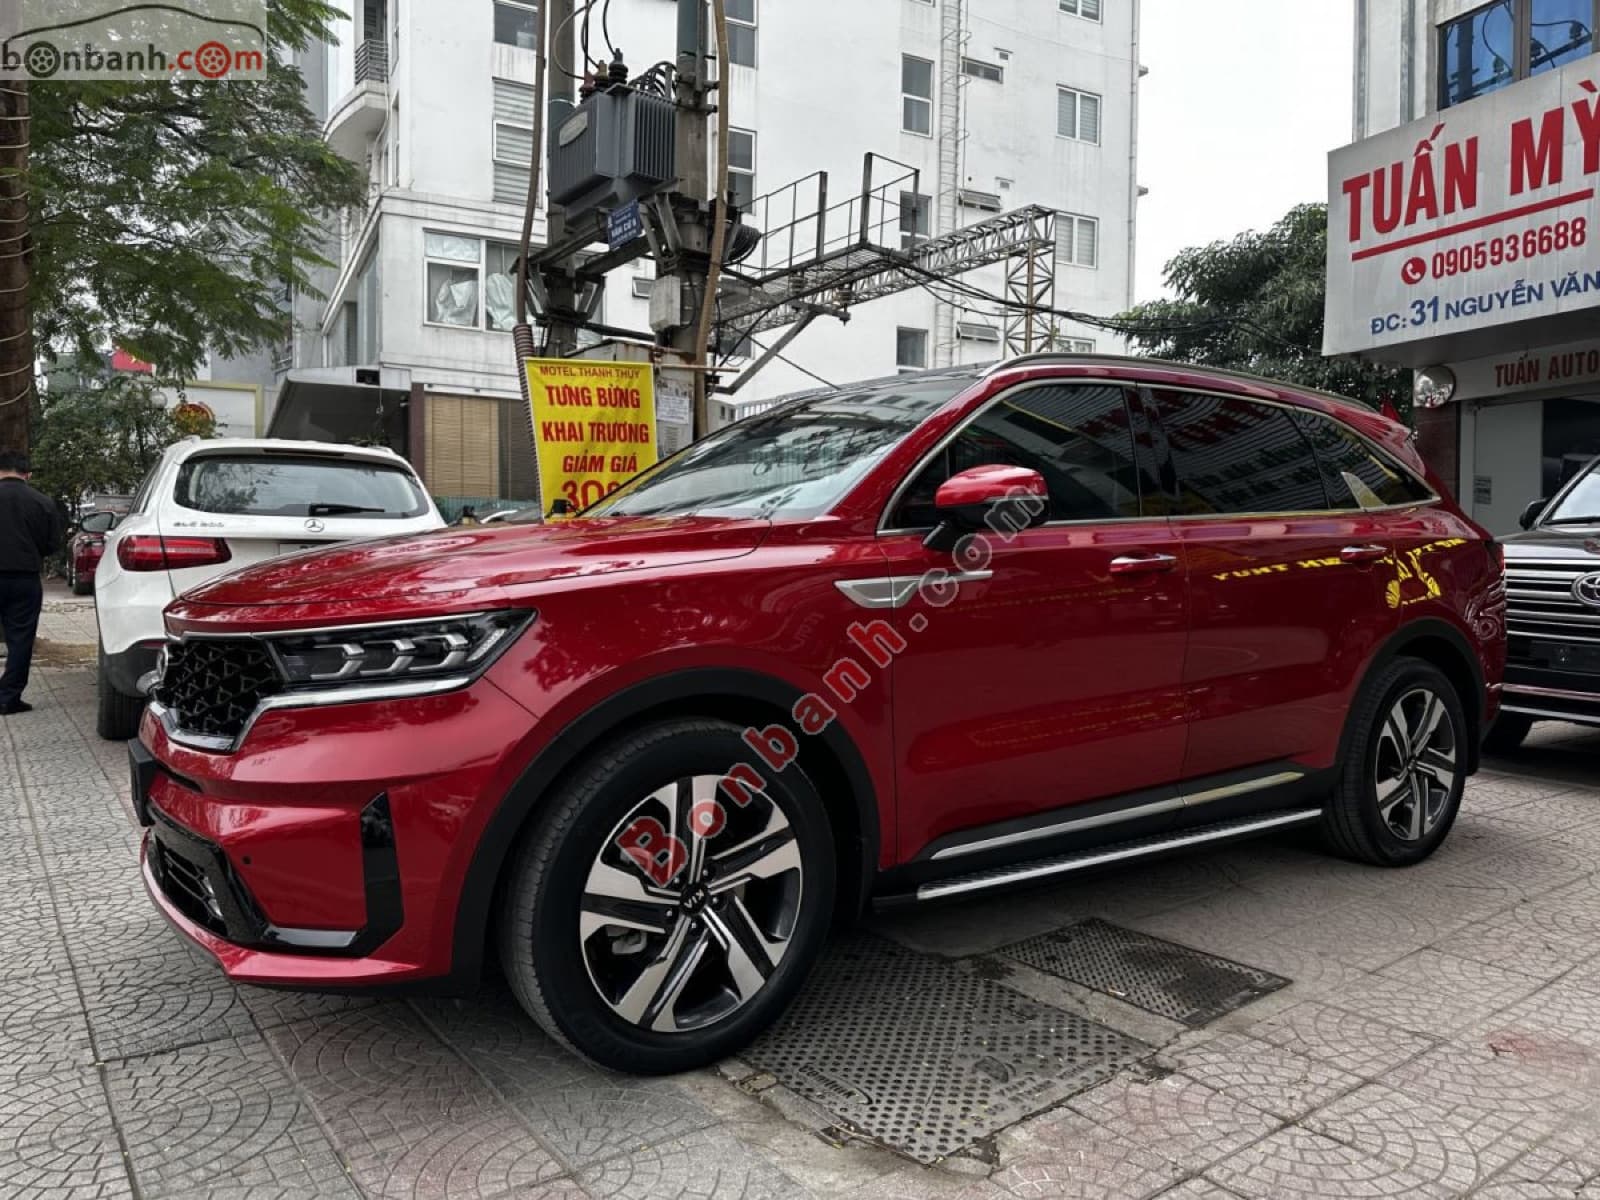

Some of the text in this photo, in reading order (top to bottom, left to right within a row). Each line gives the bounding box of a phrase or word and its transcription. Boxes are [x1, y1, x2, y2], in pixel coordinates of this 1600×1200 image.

[1342, 122, 1478, 243] TUẤN
[1432, 217, 1586, 279] 0905936688
[1371, 270, 1600, 335] ĐC: 31 NGUYỄN VĂN
[540, 366, 576, 376] MOTEL
[1495, 350, 1599, 387] TUẤN AUTO
[542, 421, 584, 442] KHAI
[561, 479, 621, 513] 30
